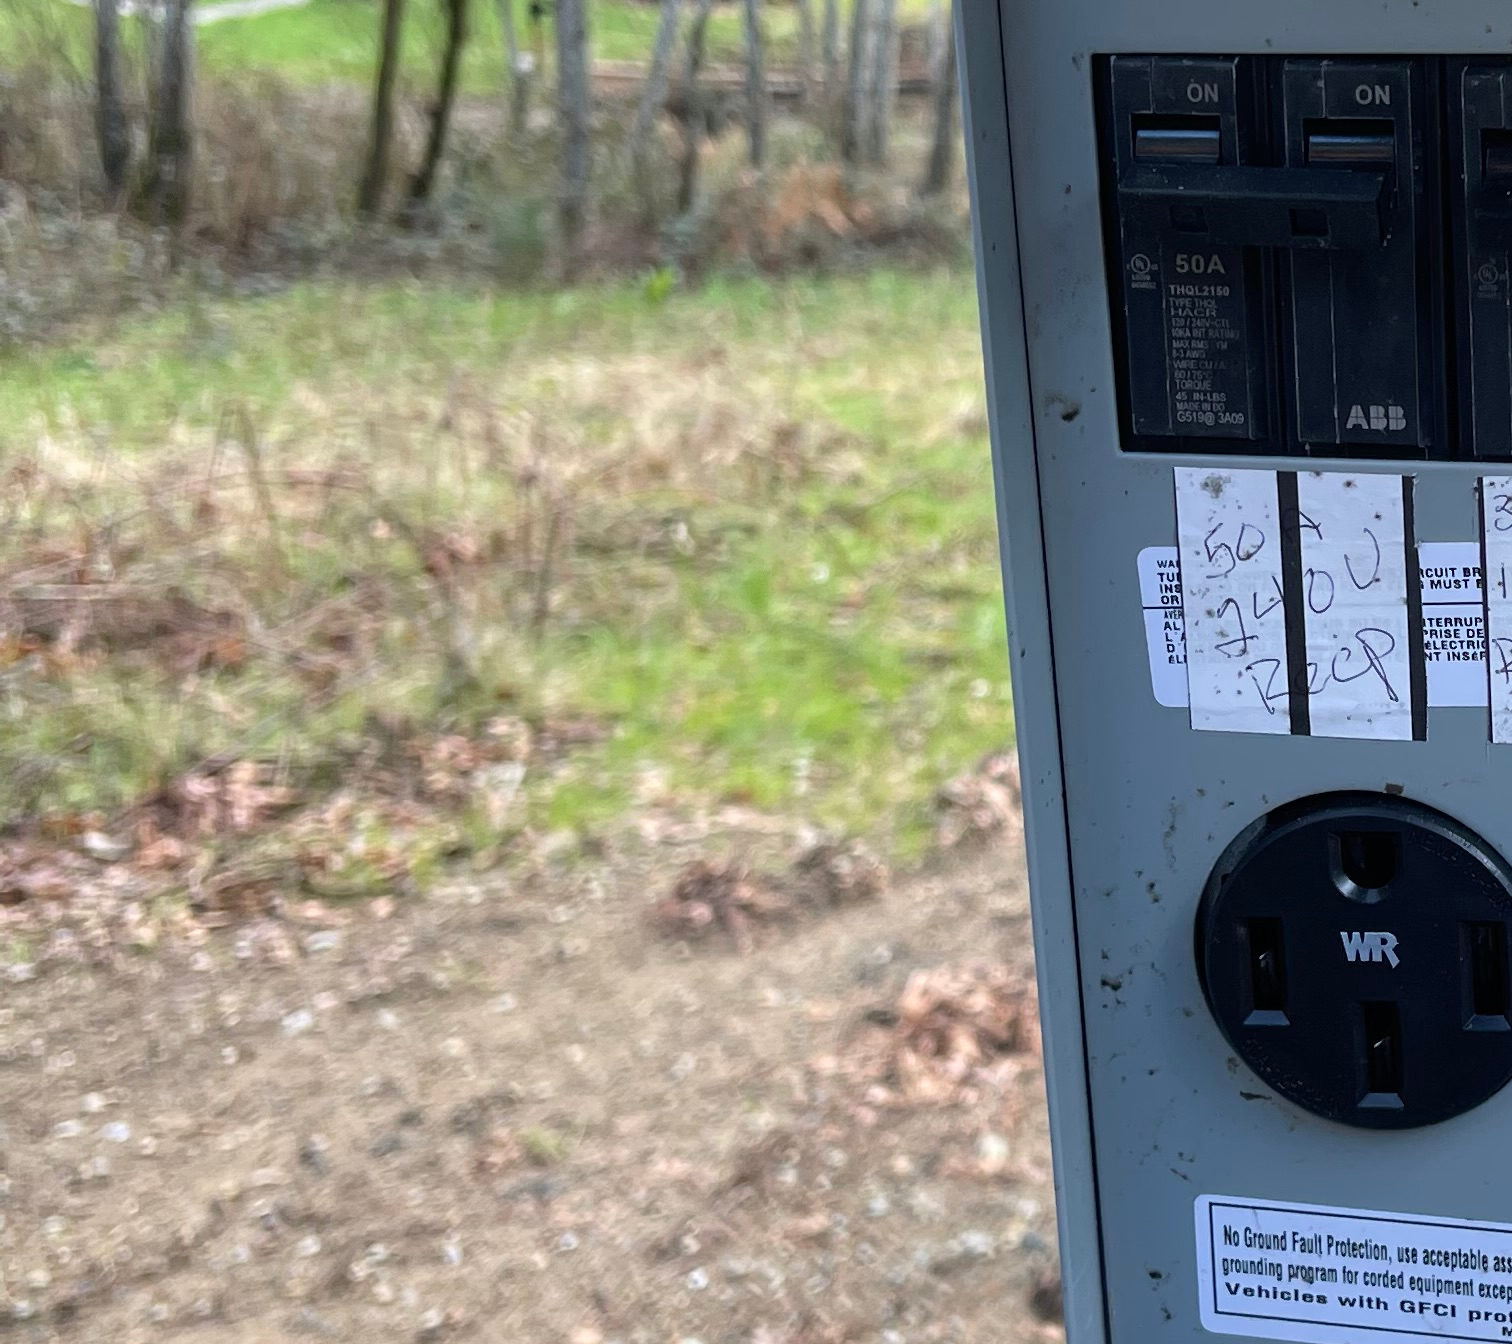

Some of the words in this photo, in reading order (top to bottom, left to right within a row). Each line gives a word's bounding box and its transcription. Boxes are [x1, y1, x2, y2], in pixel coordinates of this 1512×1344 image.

[1187, 82, 1220, 104] ON
[1354, 84, 1392, 106] ON
[1175, 253, 1227, 275] 50A
[1345, 404, 1408, 432] ABB
[1429, 578, 1470, 591] MUST
[1160, 595, 1180, 606] OR
[1339, 931, 1401, 969] WR
[1223, 1224, 1240, 1247] No
[1243, 1226, 1287, 1252] Ground
[1291, 1231, 1323, 1255] Fault
[1326, 1234, 1392, 1263] Protection,
[1397, 1246, 1418, 1265] use
[1422, 1248, 1489, 1273] acceptable
[1225, 1281, 1328, 1305] Vehicles
[1337, 1295, 1389, 1311] with
[1399, 1300, 1456, 1318] GFCI
